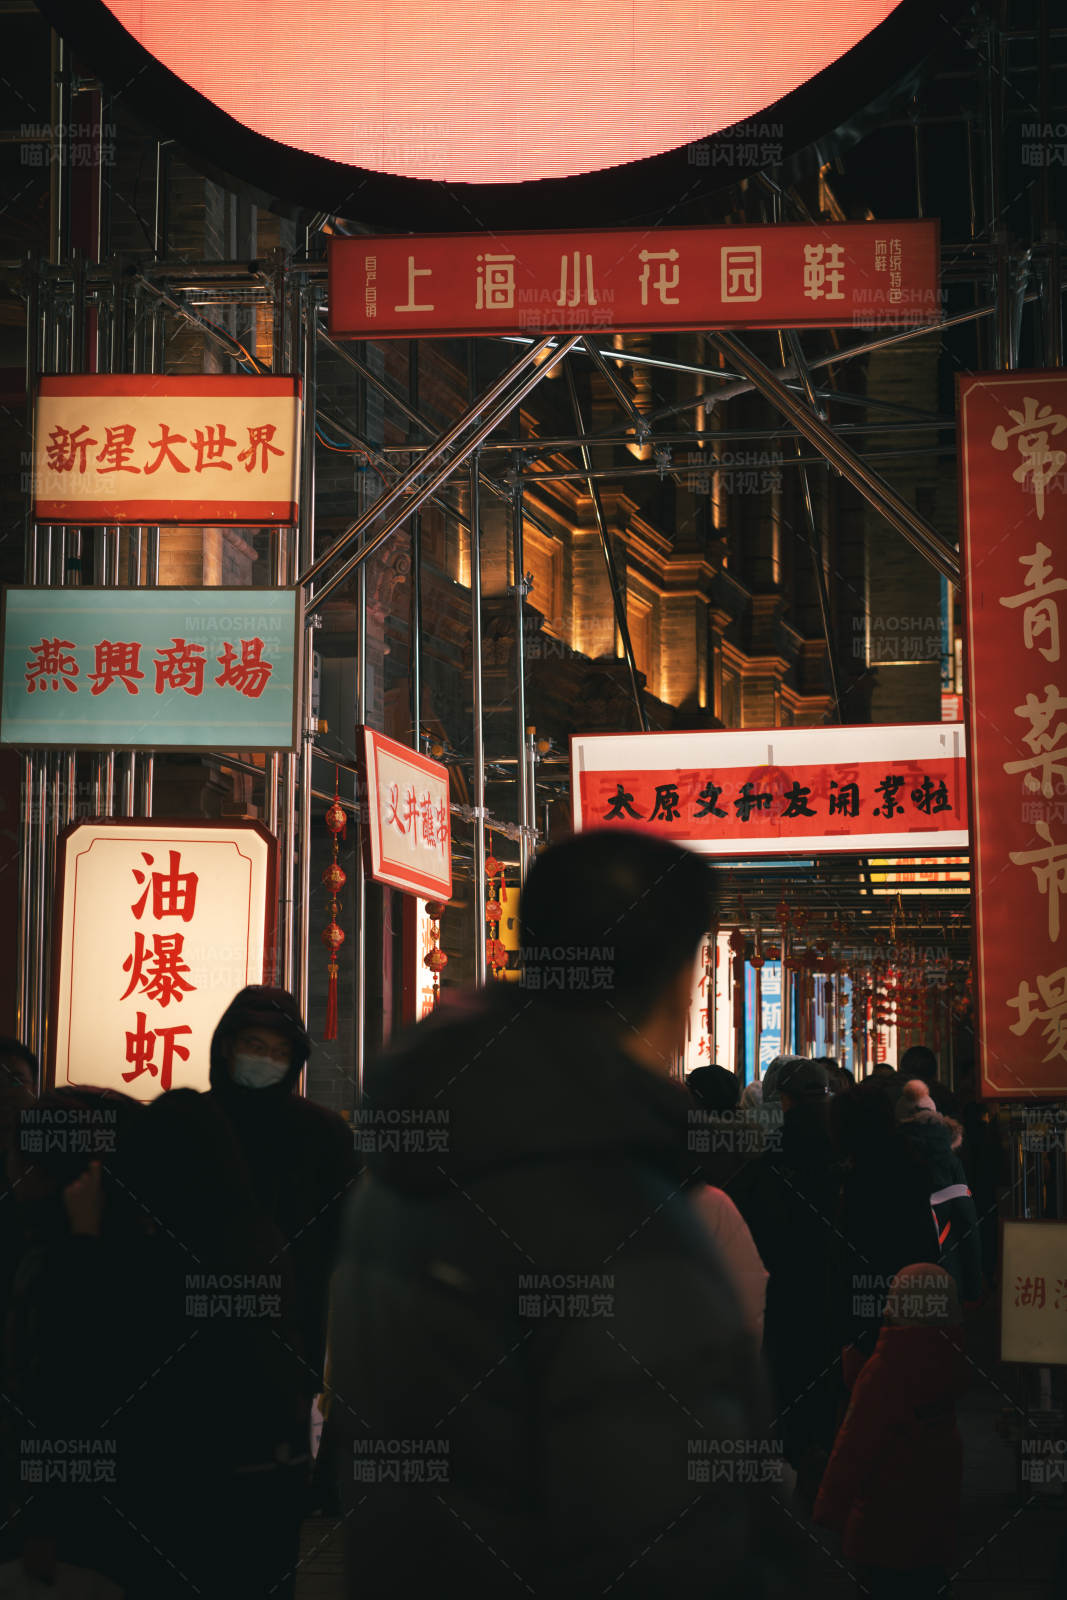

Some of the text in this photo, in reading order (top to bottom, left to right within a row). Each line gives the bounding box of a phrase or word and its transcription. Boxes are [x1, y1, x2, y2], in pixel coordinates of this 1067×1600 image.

[394, 243, 846, 313] 上海小花园鞋
[889, 239, 902, 304] 传统特色
[45, 423, 286, 475] 新星大世界
[24, 637, 274, 699] 燕興商場
[120, 849, 200, 1091] 油爆虾
